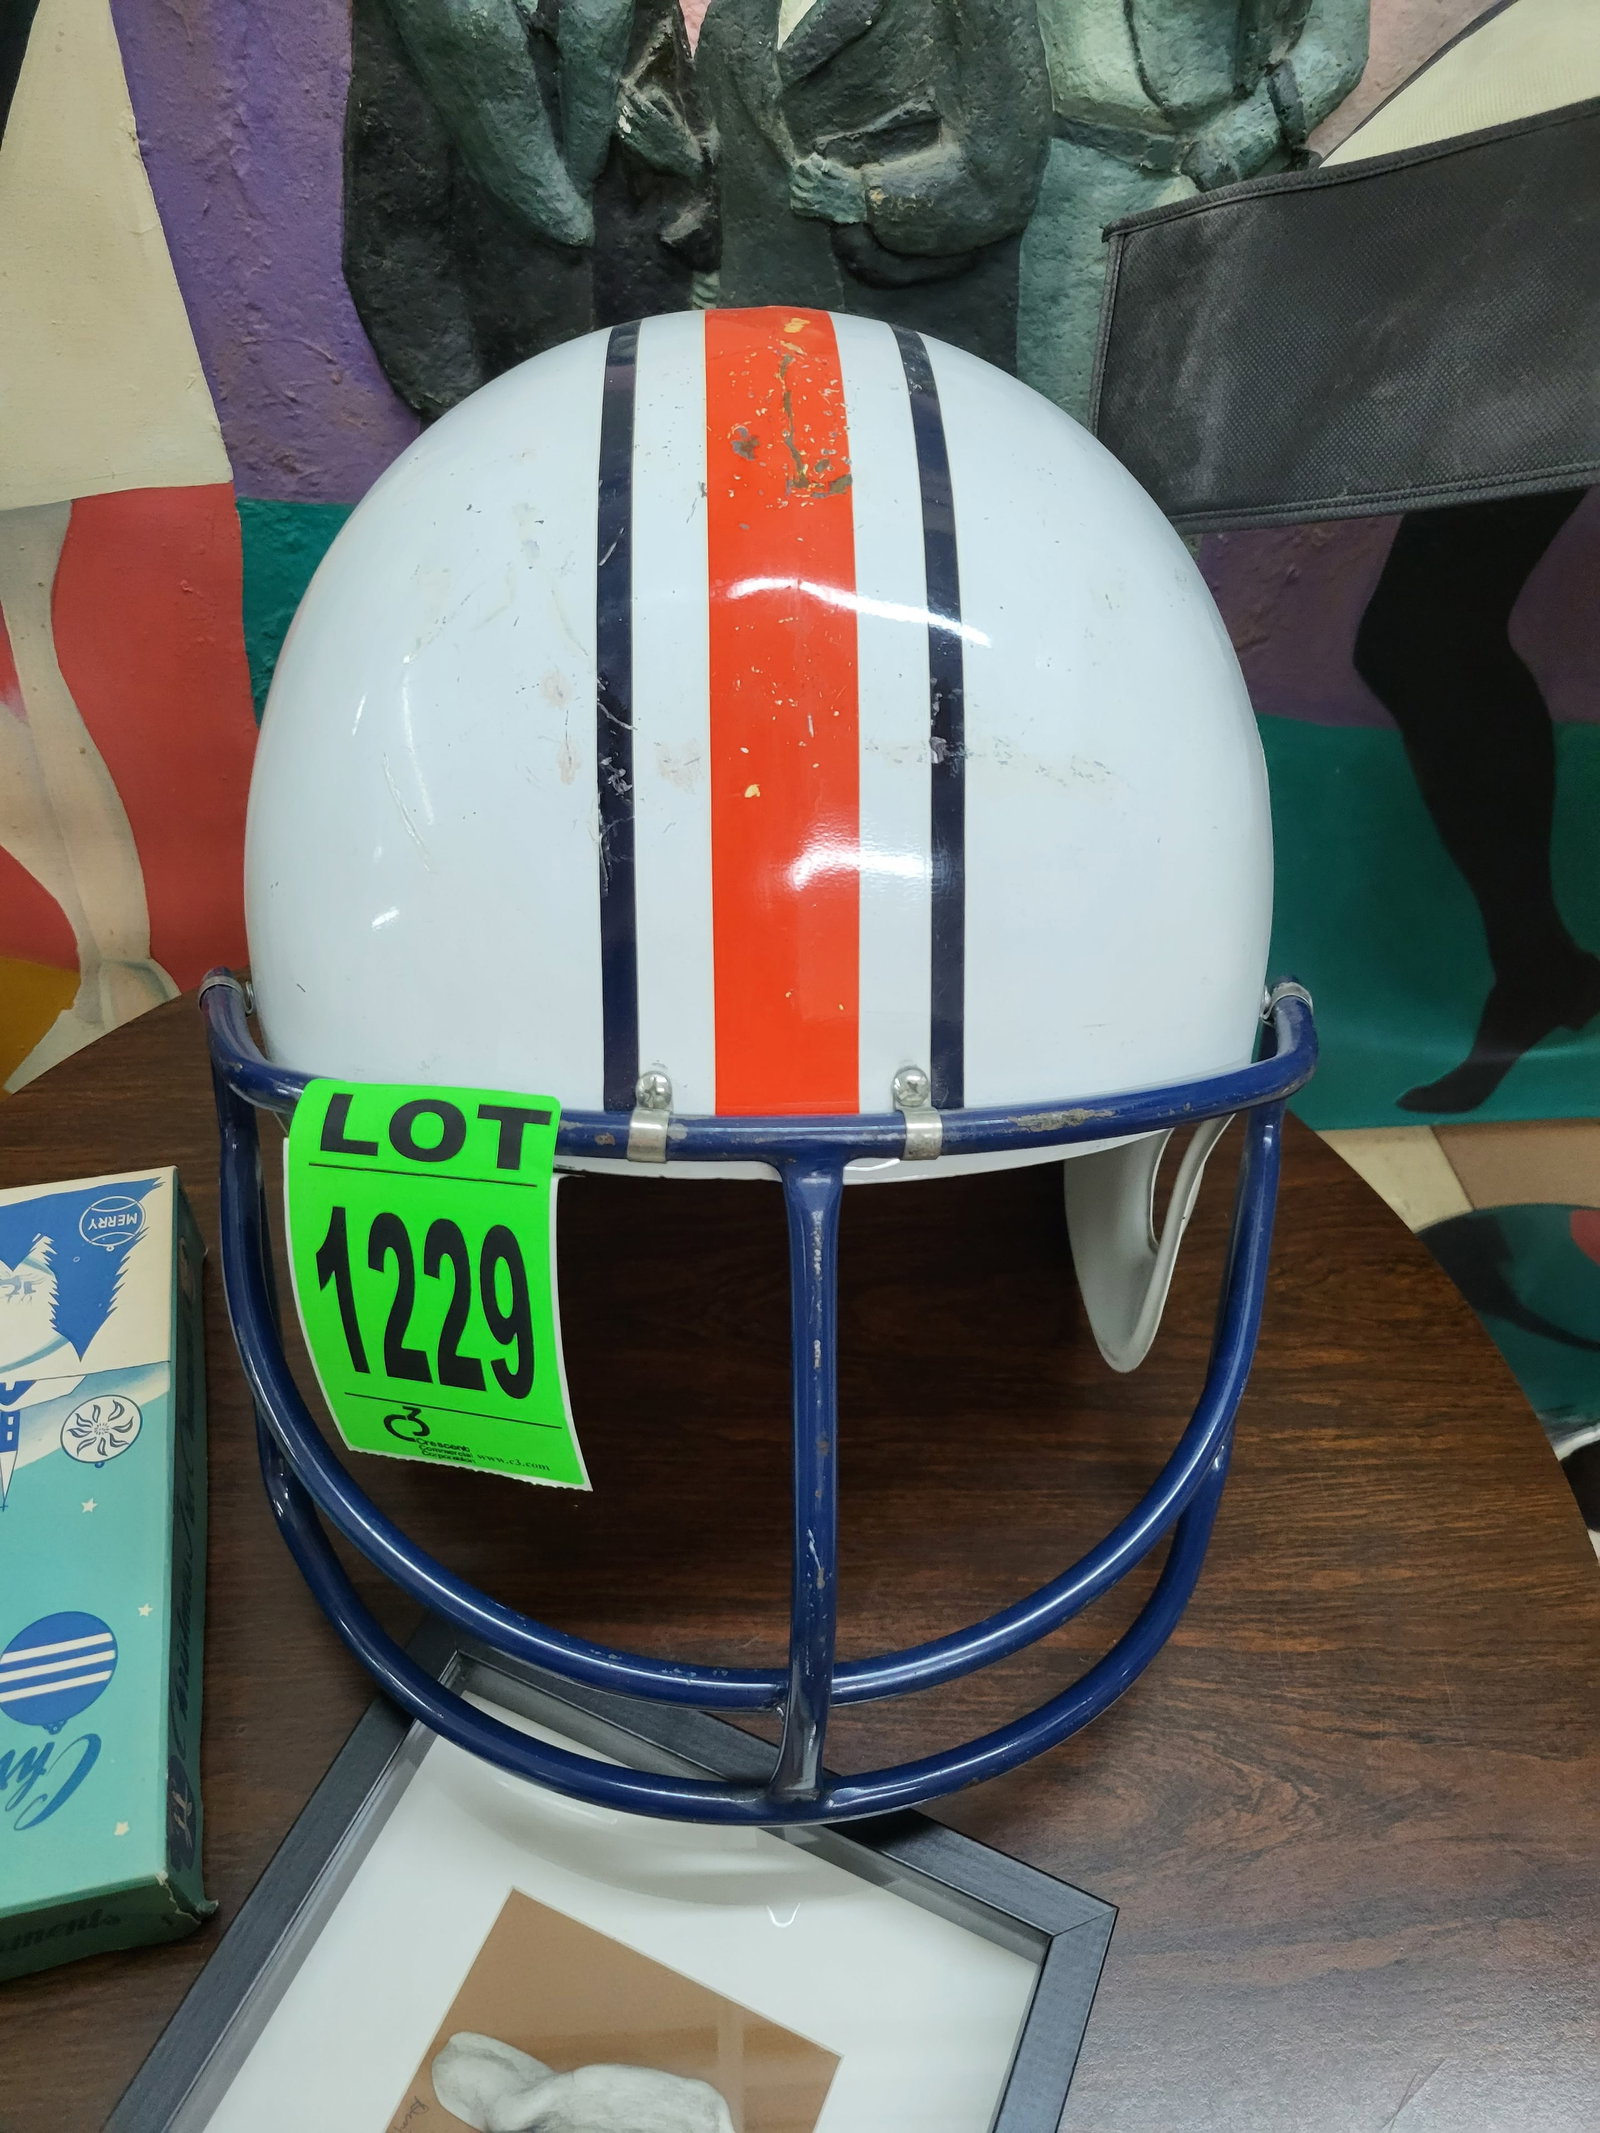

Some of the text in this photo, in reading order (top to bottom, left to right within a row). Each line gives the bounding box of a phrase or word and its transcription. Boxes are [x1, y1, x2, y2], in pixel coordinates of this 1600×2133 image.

[320, 1093, 553, 1171] LOT
[88, 1212, 138, 1231] MERRY
[316, 1206, 536, 1400] 1229
[477, 1454, 551, 1471] www.c3.com
[0, 1908, 122, 1952] ments
